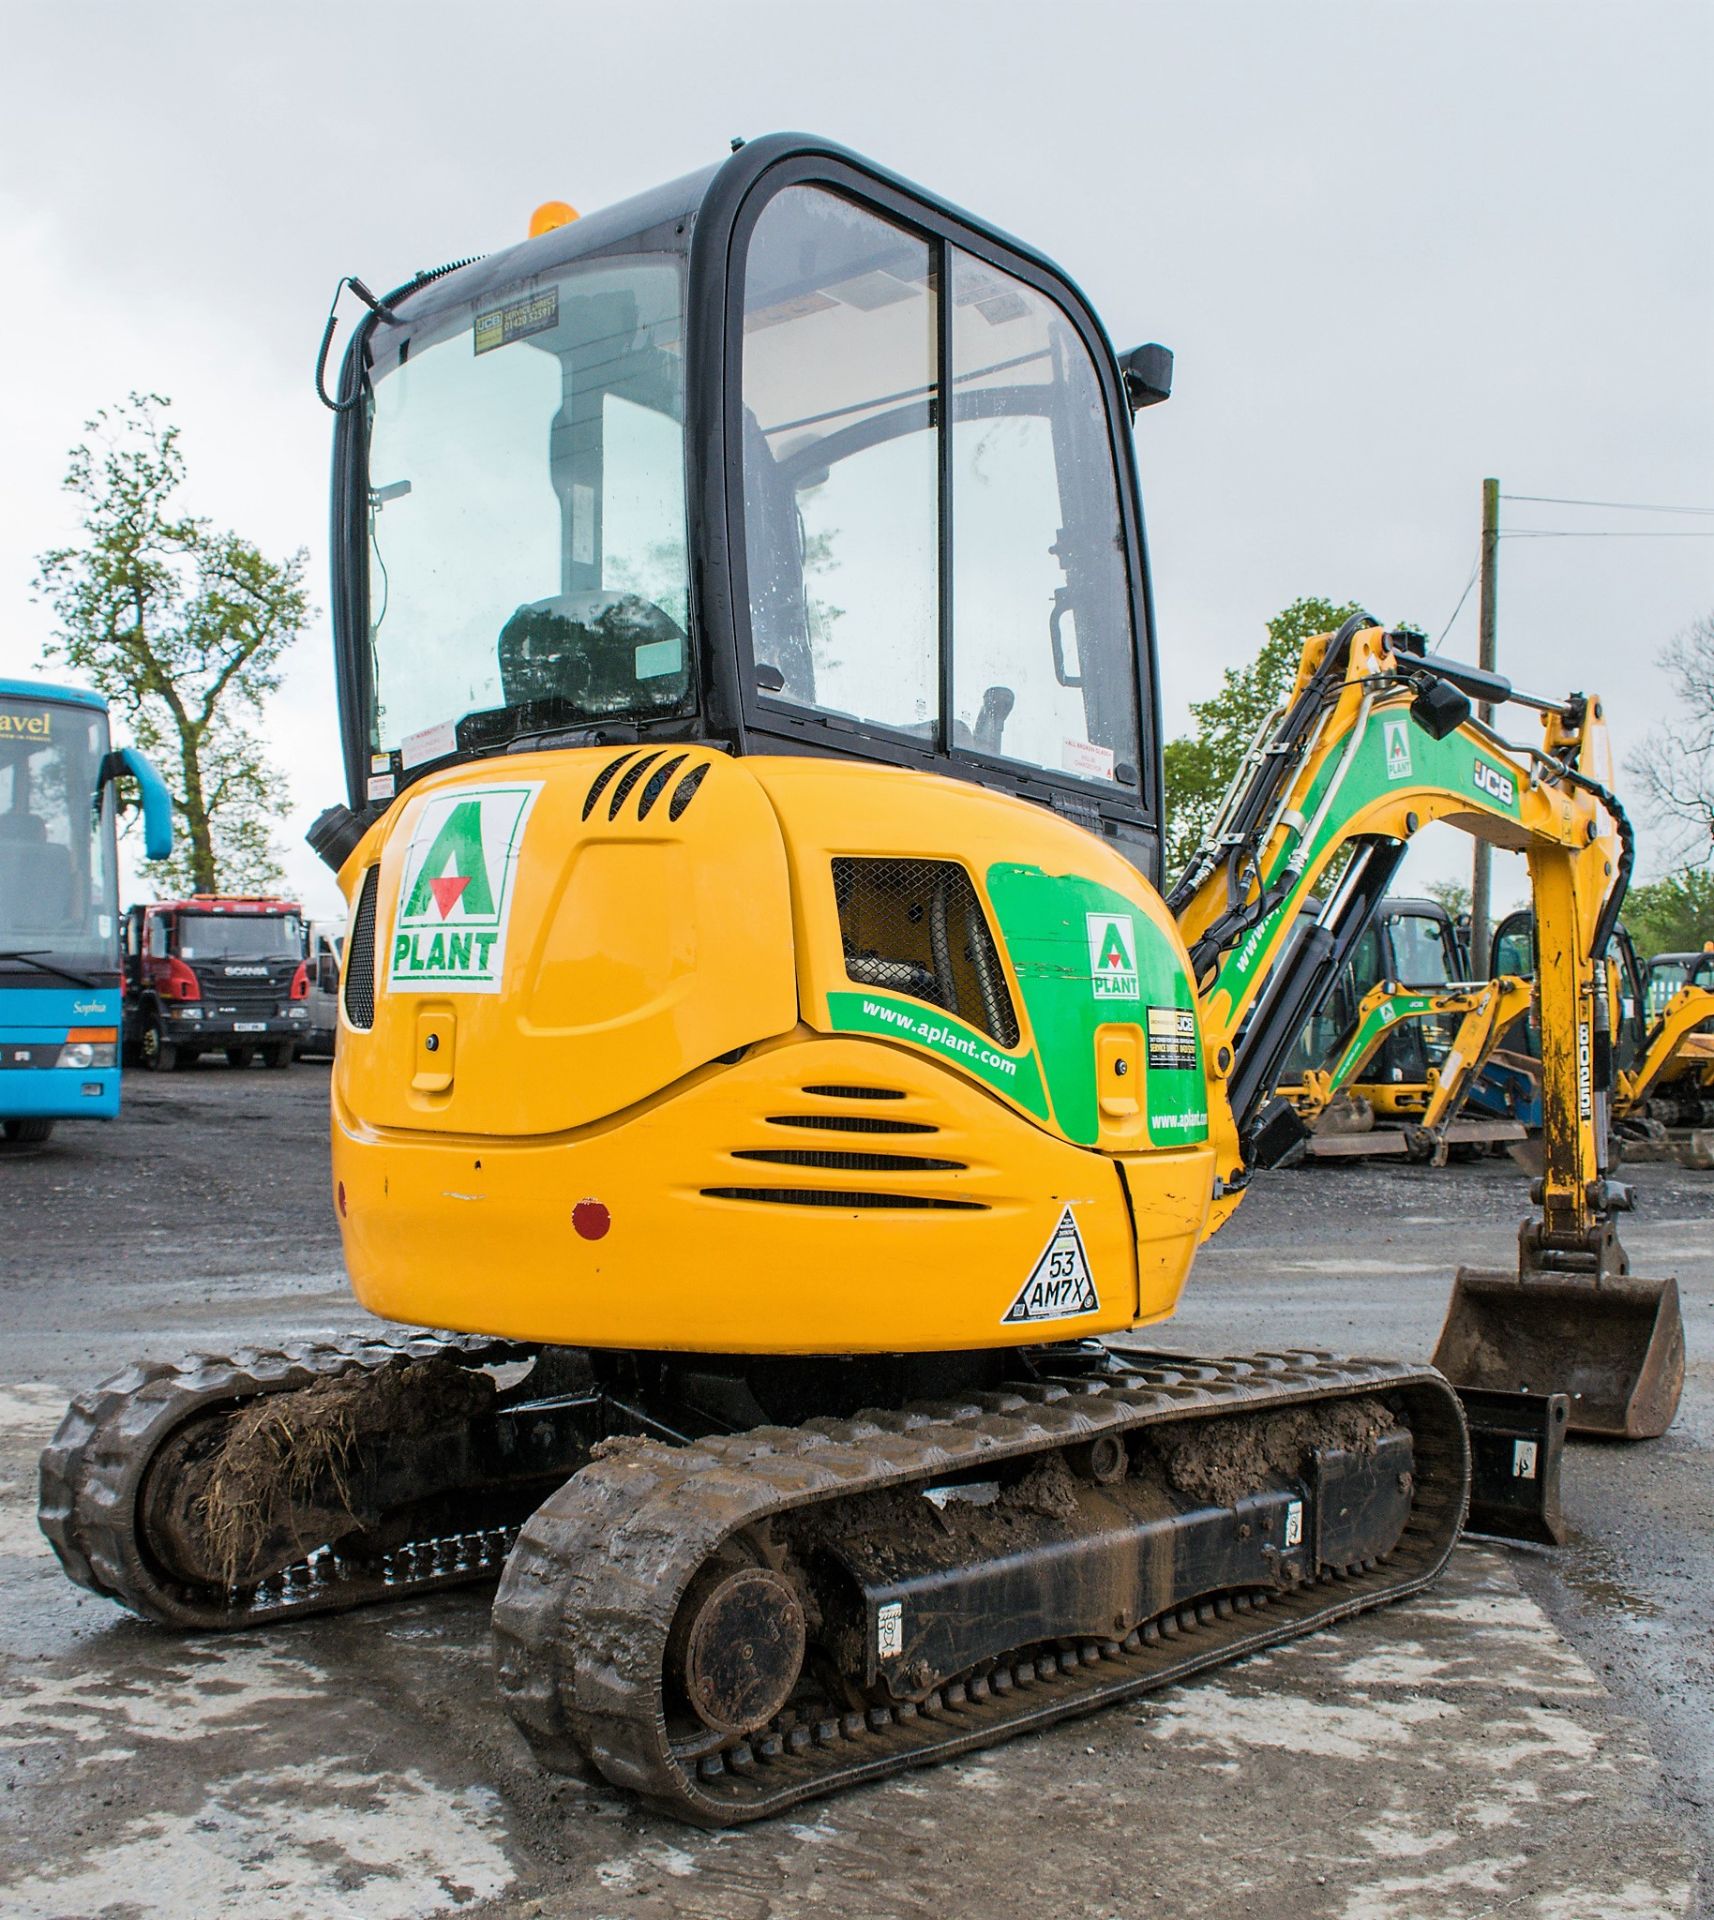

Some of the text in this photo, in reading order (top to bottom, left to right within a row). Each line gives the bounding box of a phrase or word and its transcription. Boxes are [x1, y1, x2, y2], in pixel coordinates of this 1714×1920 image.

[478, 315, 501, 332] JCB
[1389, 761, 1410, 775] PLANT
[1474, 763, 1513, 806] JCB
[393, 931, 499, 971] PLANT
[224, 966, 269, 976] SCANIA
[1095, 976, 1137, 994] PLANT
[73, 1000, 107, 1017] Sophia
[863, 1000, 1017, 1076] www.aplant.com
[1579, 1023, 1591, 1109] 8025
[1049, 1250, 1076, 1279] 53
[1029, 1277, 1085, 1308] AM7X
